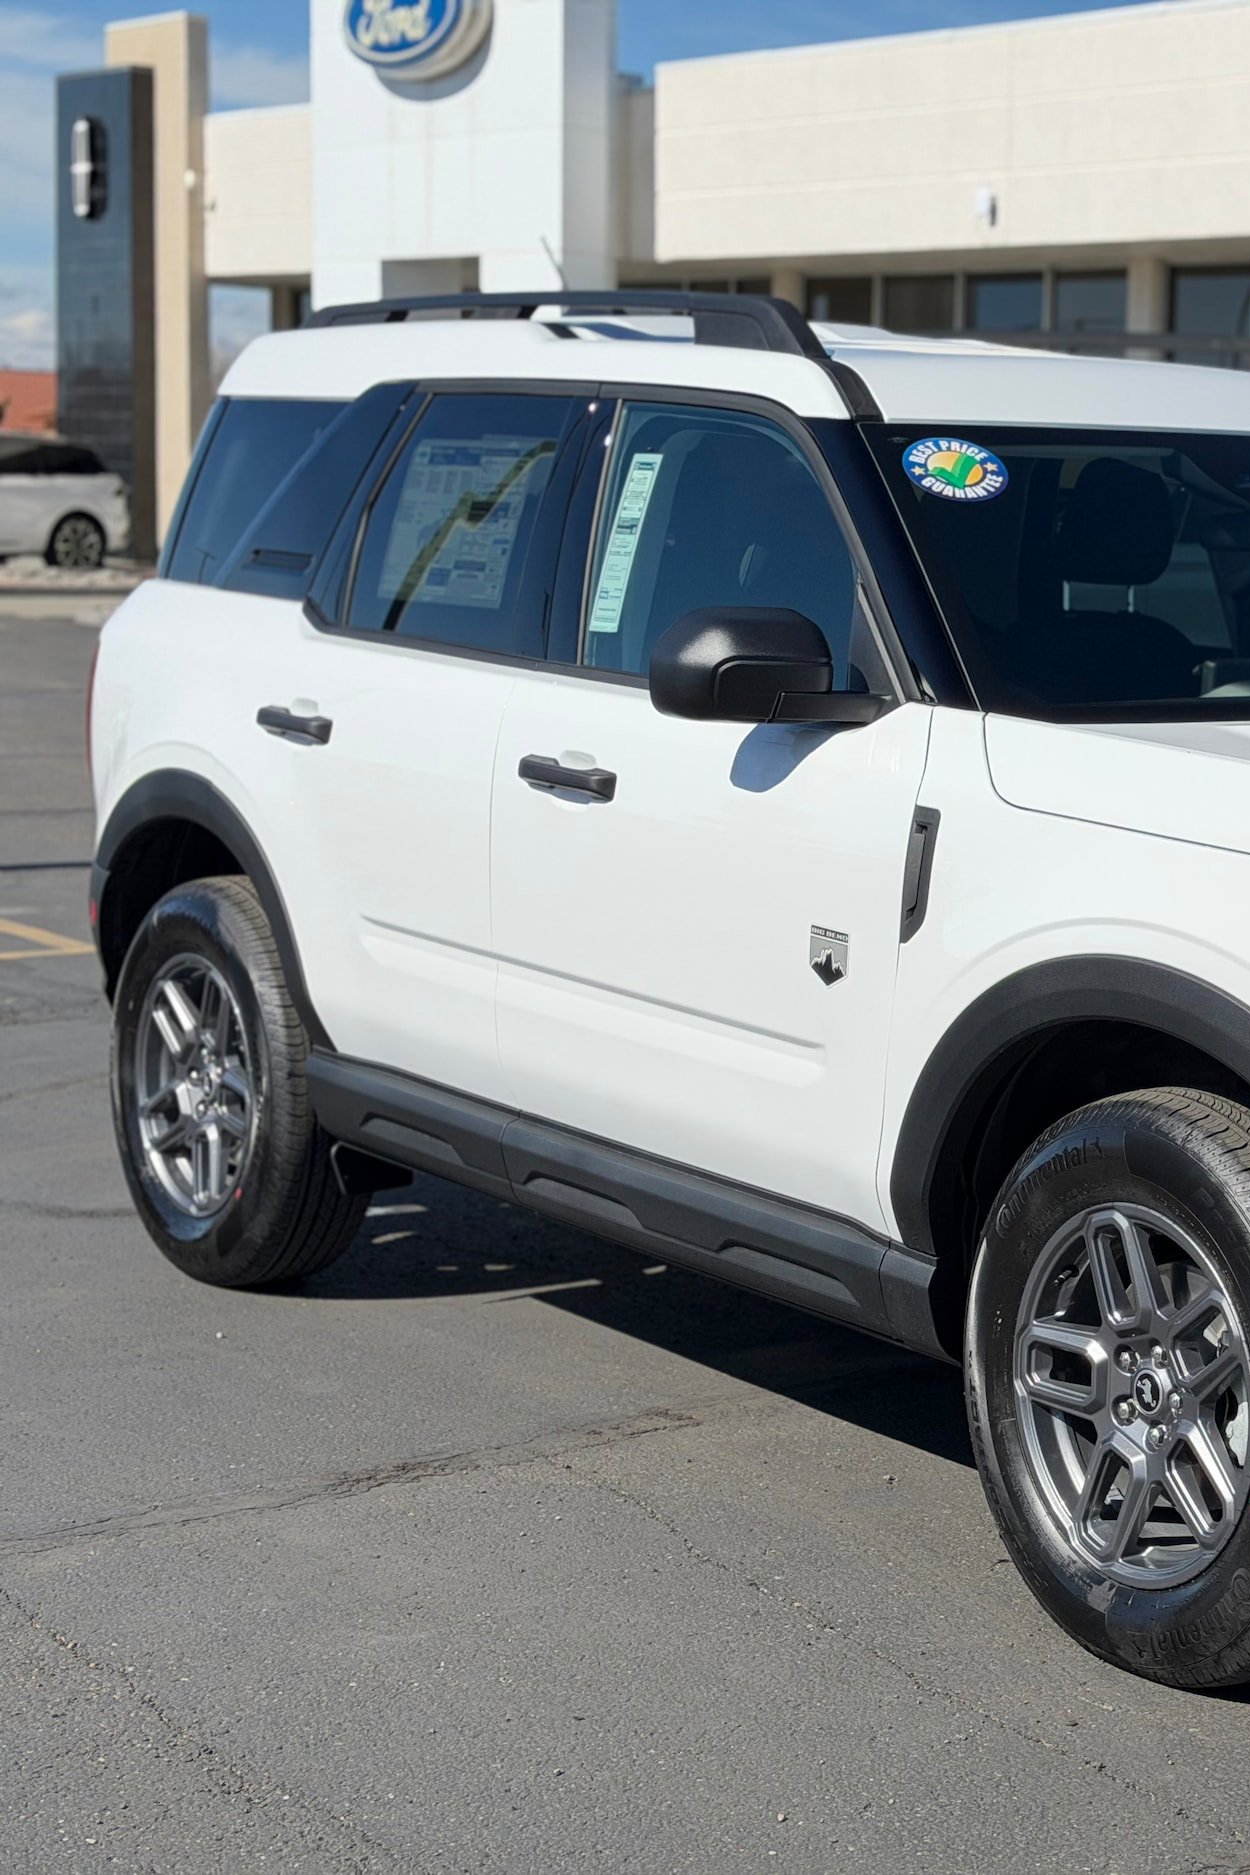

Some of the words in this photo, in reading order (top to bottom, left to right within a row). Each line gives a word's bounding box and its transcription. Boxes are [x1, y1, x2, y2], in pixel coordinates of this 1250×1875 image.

[908, 441, 939, 464] BEST
[938, 440, 988, 461] PRICE
[920, 473, 1004, 499] GUARANTEE
[811, 926, 825, 936] BIG
[825, 931, 849, 942] BEND
